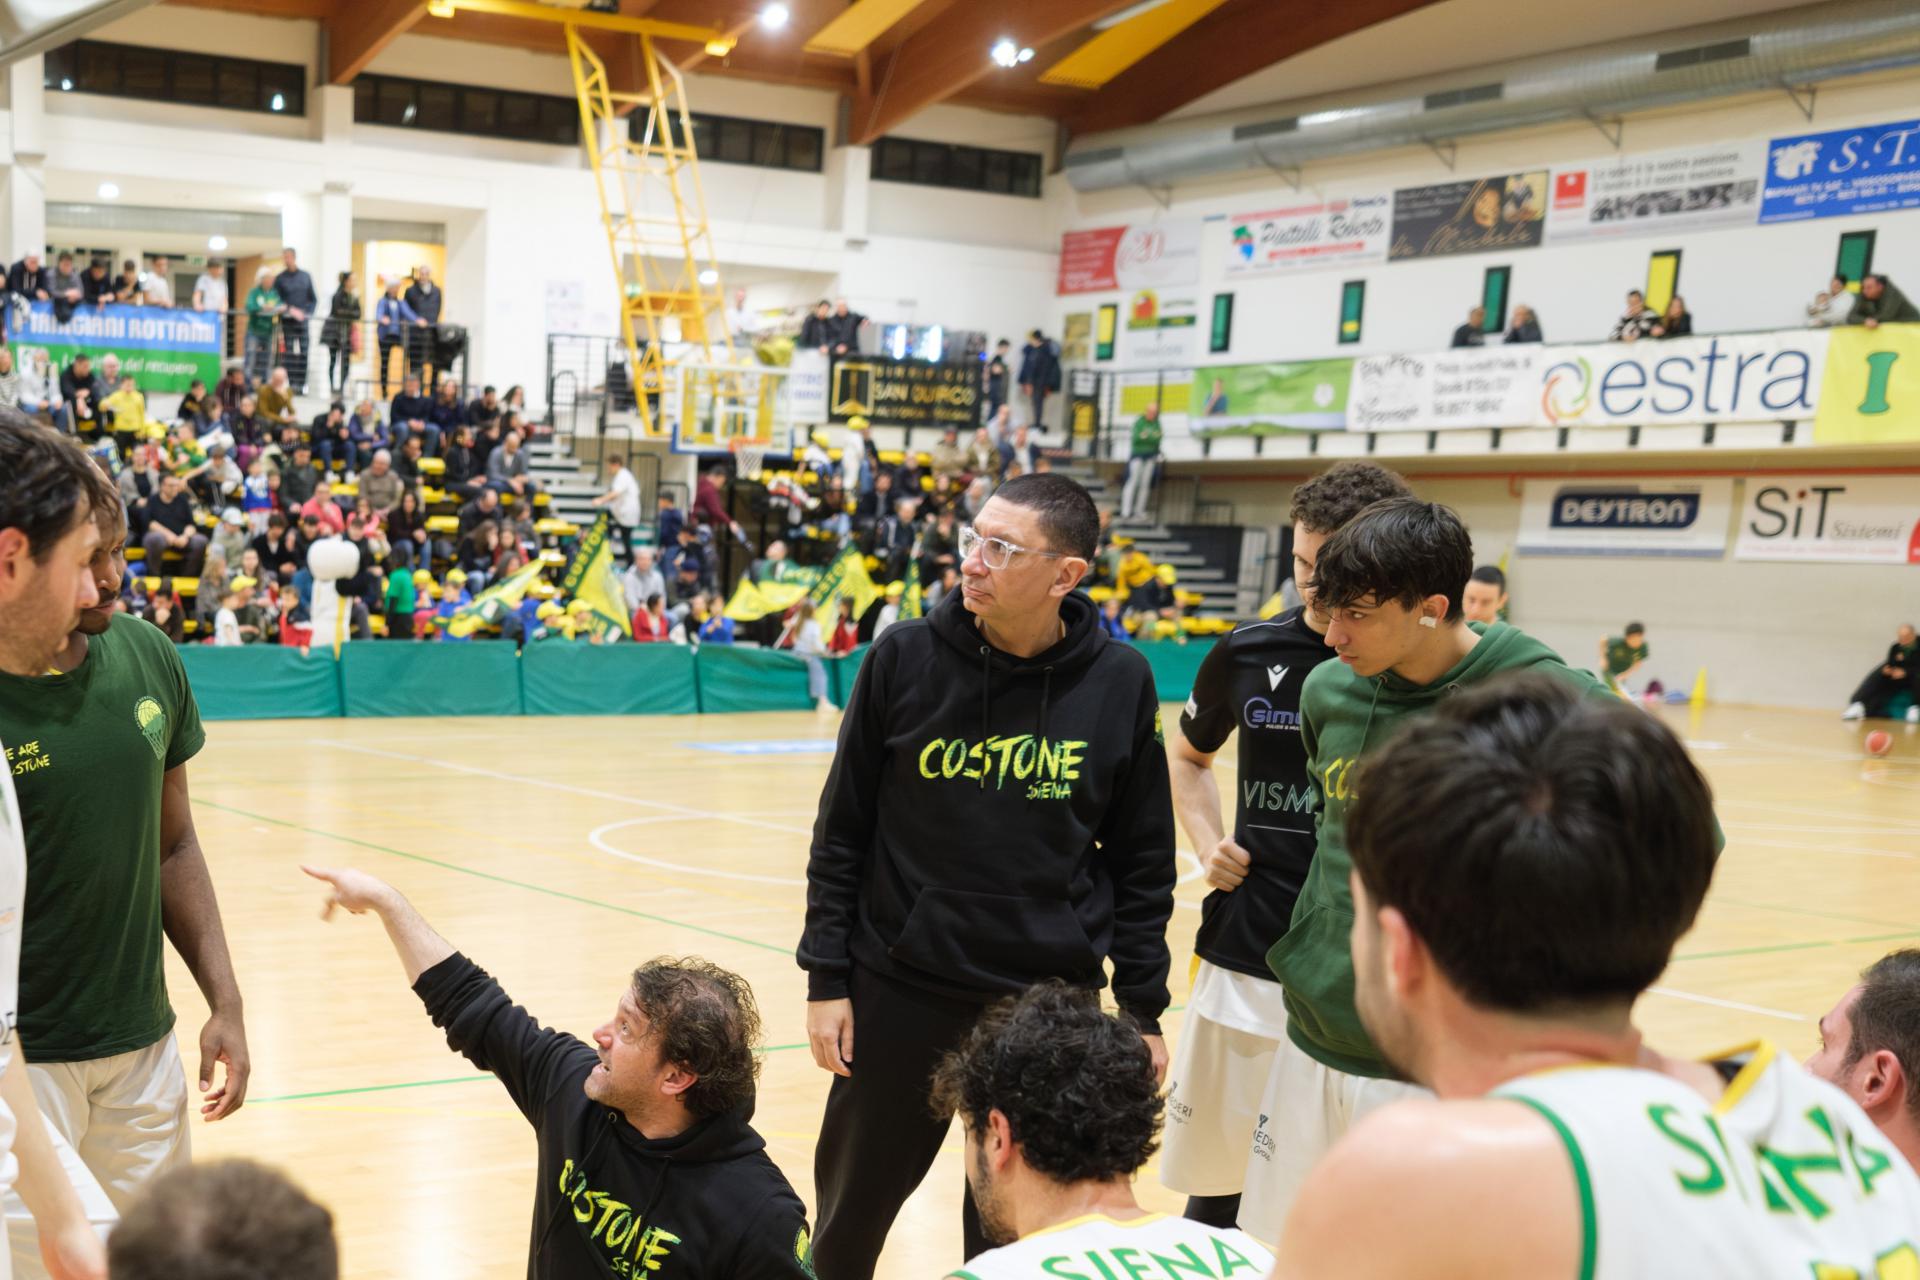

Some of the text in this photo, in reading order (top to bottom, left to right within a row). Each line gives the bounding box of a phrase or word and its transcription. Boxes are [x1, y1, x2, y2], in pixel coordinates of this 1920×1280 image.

[1600, 339, 1817, 417] estra
[1560, 498, 1690, 524] DEYTRON
[1751, 486, 1846, 539] SiT
[18, 740, 40, 757] ARE
[919, 735, 1089, 791] COSTONE
